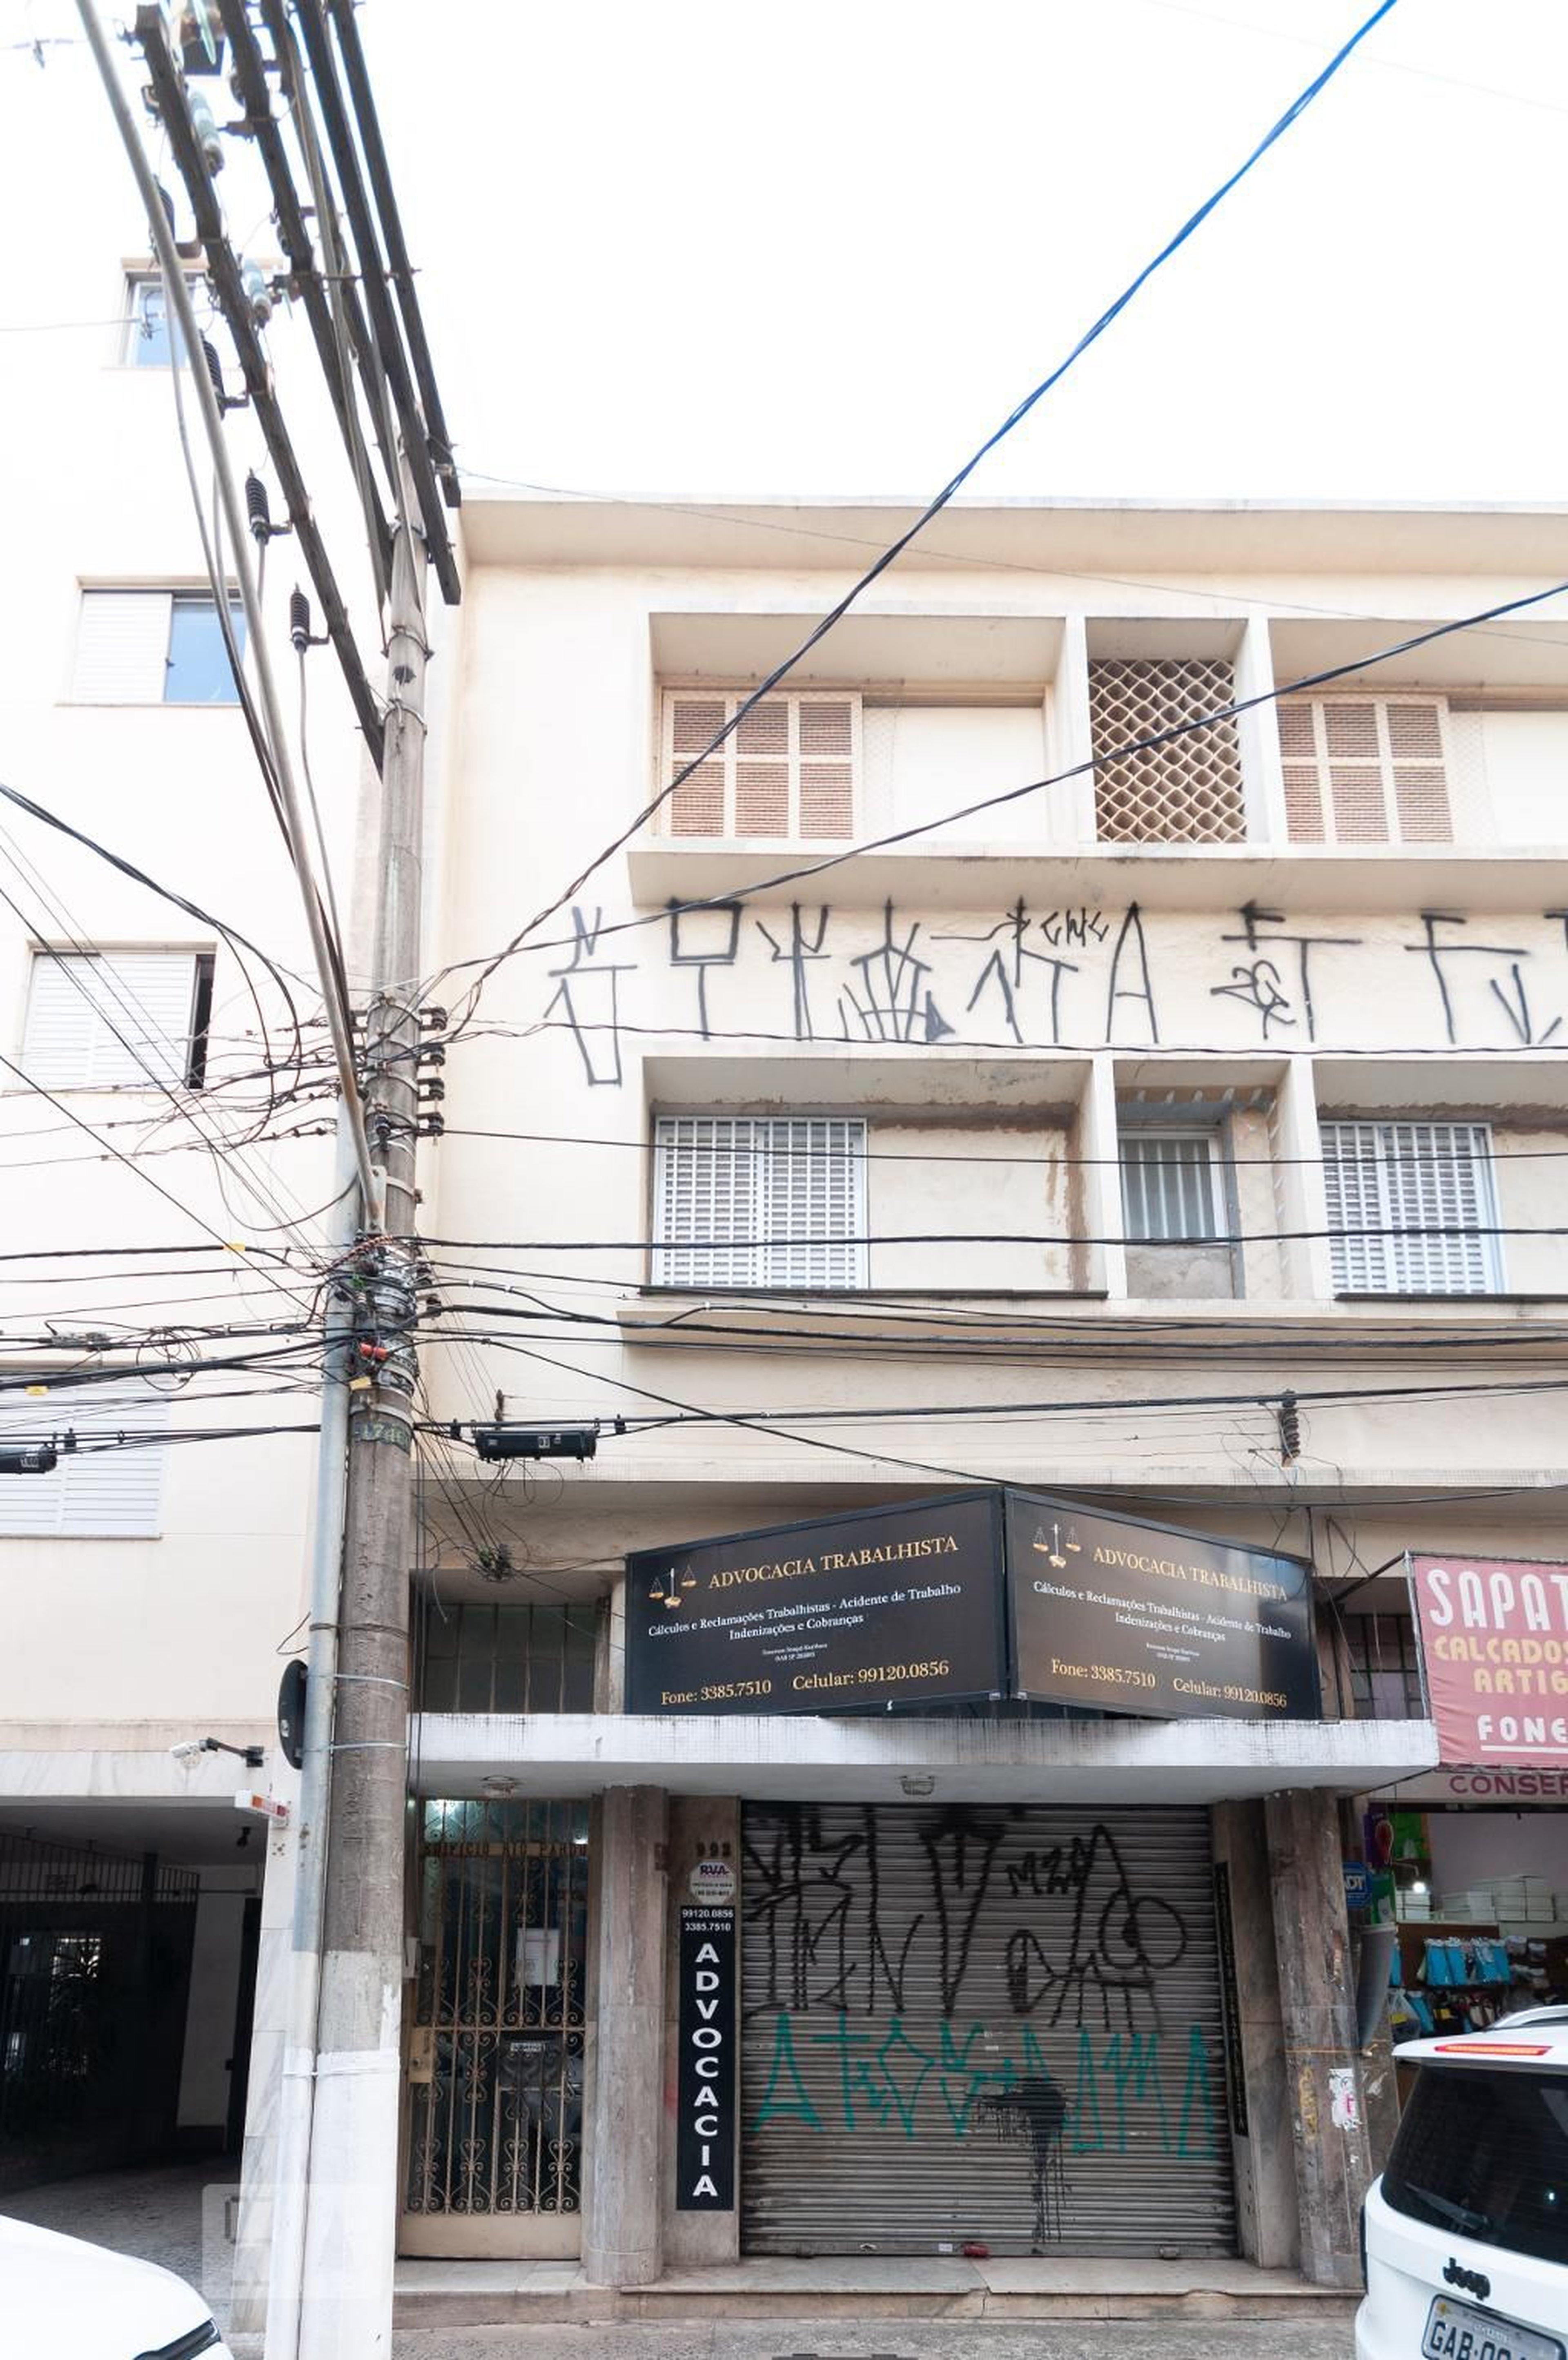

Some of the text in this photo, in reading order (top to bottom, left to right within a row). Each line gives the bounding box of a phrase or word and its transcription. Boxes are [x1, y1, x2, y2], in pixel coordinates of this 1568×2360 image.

[708, 1535, 959, 1589] ADVOCACIA TRABALHISTA
[1094, 1546, 1287, 1600] ADVOCACIA TRABALHISTA
[648, 1622, 690, 1637] Cálculos
[700, 1611, 764, 1629] Reclamações
[766, 1603, 830, 1618] Trabalhistas
[839, 1594, 889, 1609] Acidente
[891, 1591, 905, 1603] de
[908, 1584, 961, 1600] Trabalho
[730, 1622, 795, 1640] Indenizações
[806, 1614, 864, 1630] Cobranças
[1033, 1581, 1076, 1598] Cálculos
[1086, 1591, 1146, 1611] Reclamações
[1147, 1602, 1200, 1621] Trabalhistas
[1256, 1623, 1292, 1639] Trabalho
[1115, 1613, 1173, 1632] Indenizações
[1182, 1624, 1225, 1642] Cobranças
[661, 1660, 949, 1705] Fone: 3385.7510 Celular: 99120.0856
[1051, 1658, 1287, 1709] Fone: 3385.7510 Celular: 99120.0856
[1345, 1874, 1366, 1891] DT
[682, 1909, 734, 1918] 99120.0856
[685, 1922, 731, 1932] 3385.7510
[692, 1943, 723, 2198] ADVOCACIA
